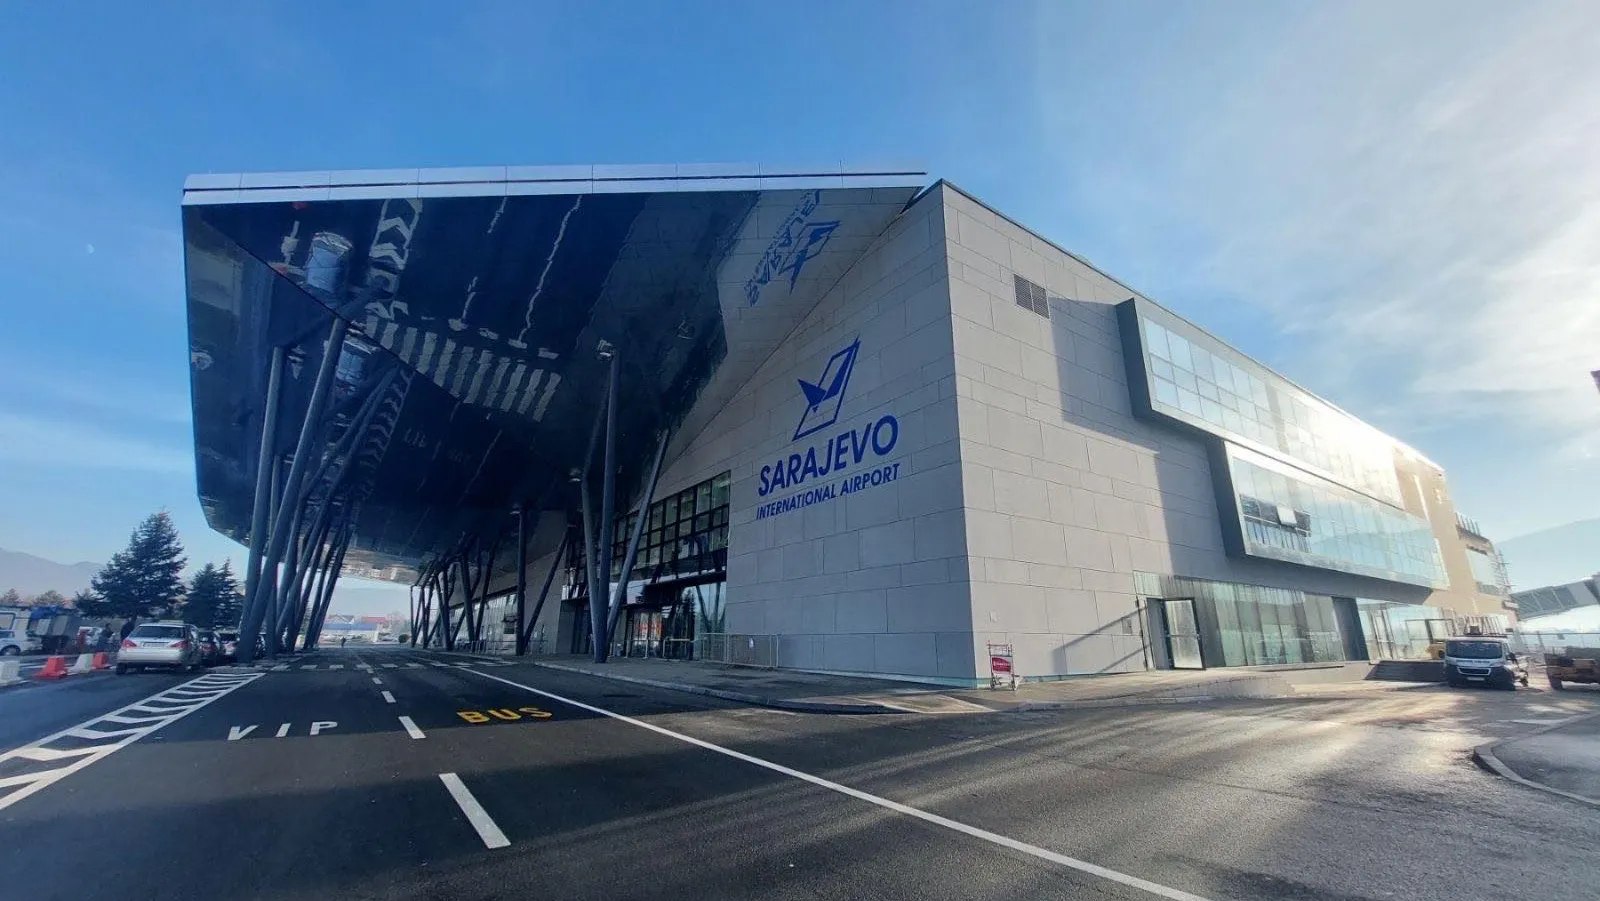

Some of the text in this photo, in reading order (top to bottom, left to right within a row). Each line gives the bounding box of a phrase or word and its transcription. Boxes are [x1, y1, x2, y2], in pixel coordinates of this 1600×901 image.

[758, 415, 899, 497] SARAJEVO
[756, 463, 900, 520] INTERNATIONAL AIRPORT
[227, 721, 338, 741] VIP
[456, 708, 552, 723] BUS
